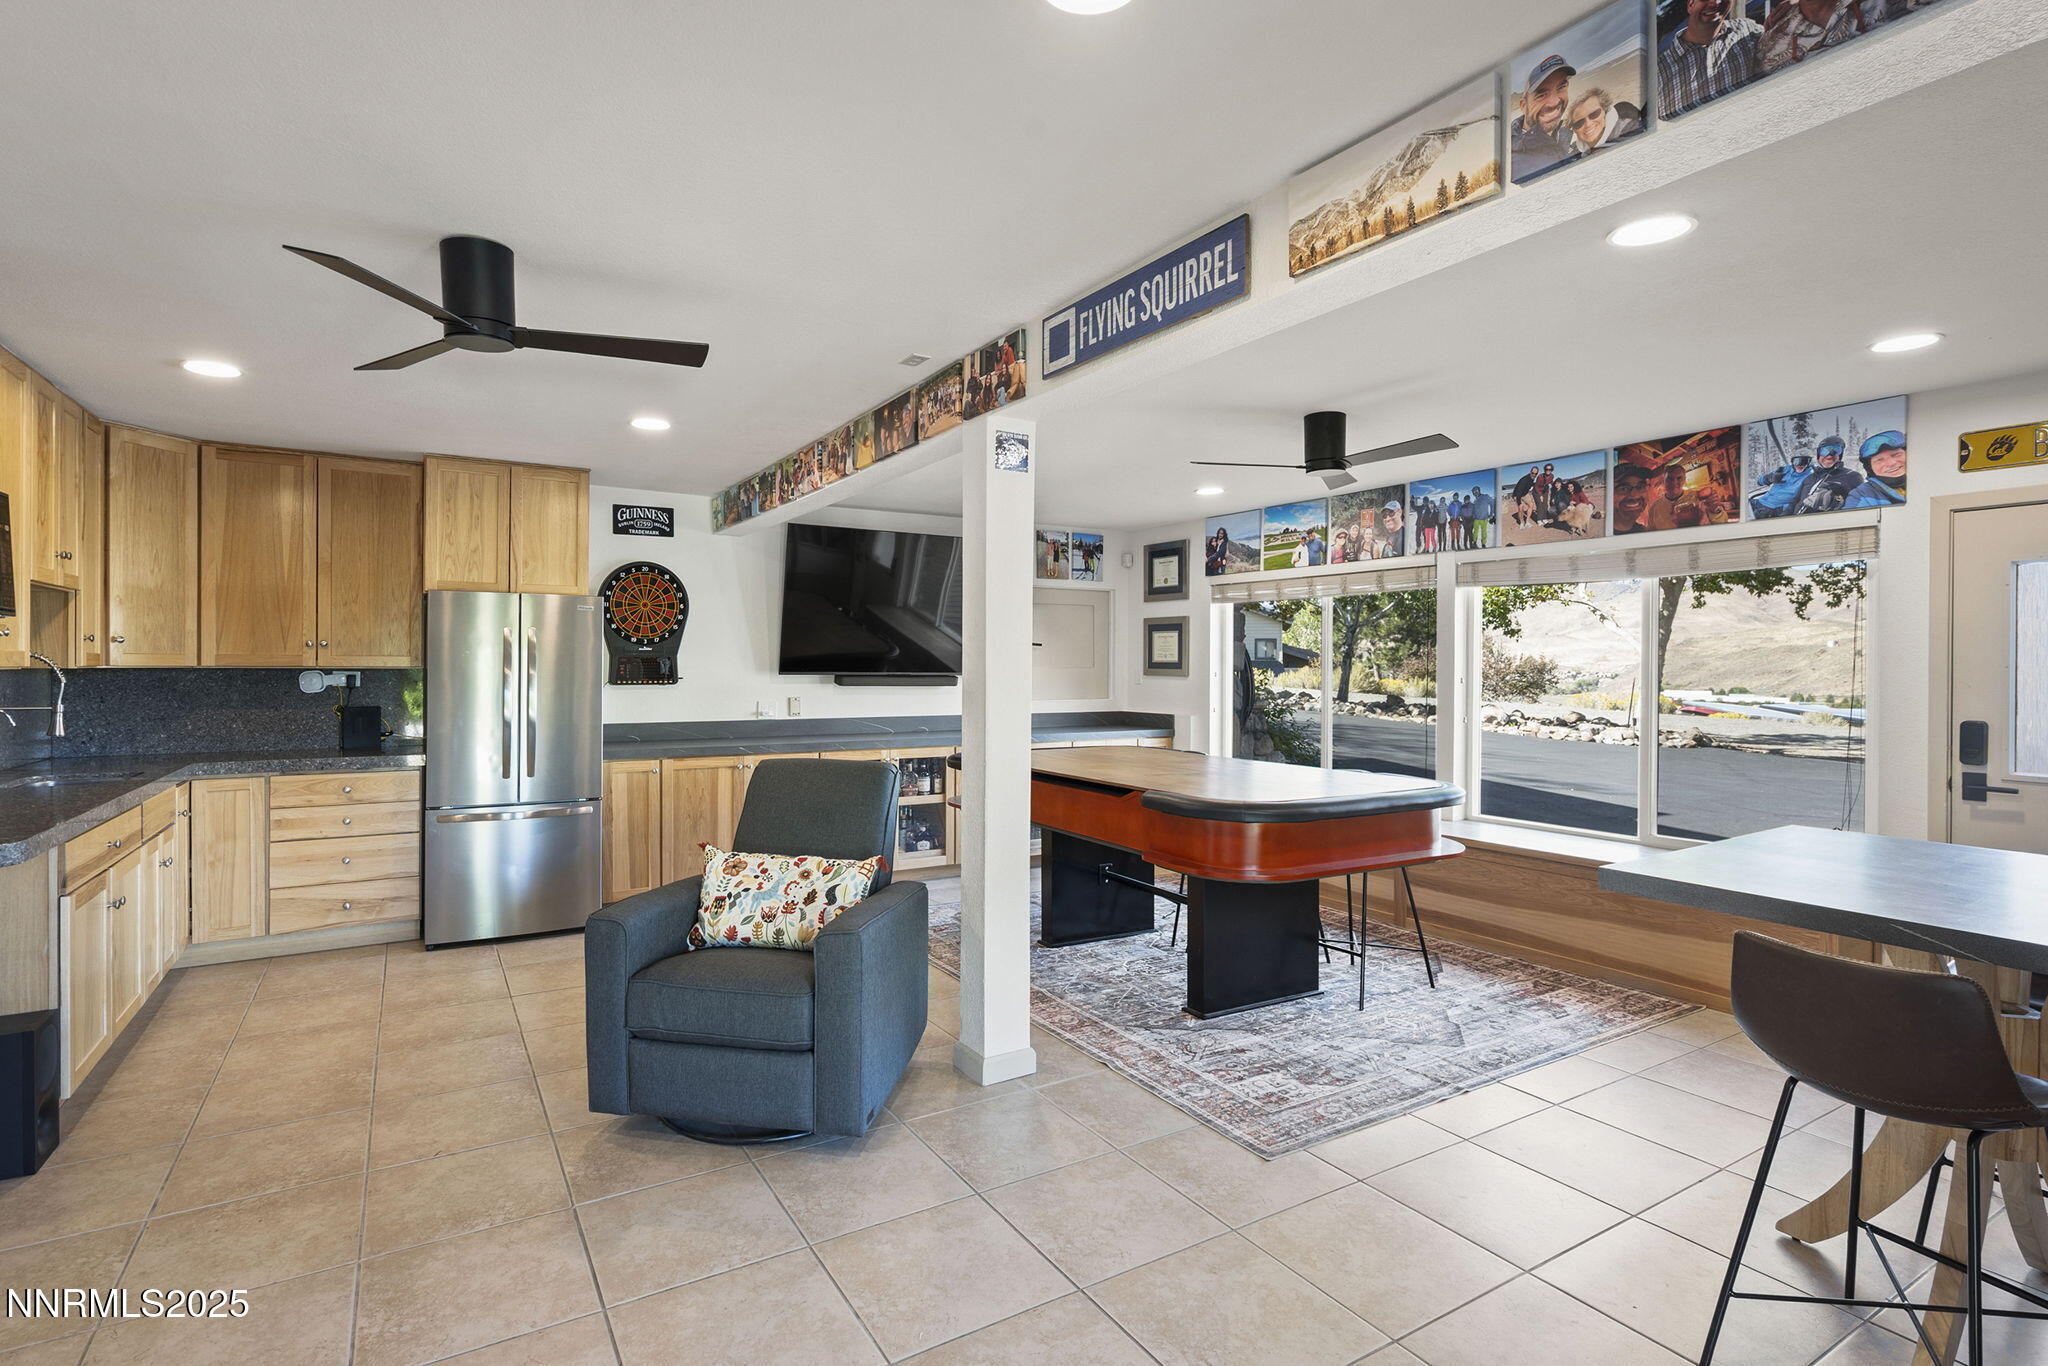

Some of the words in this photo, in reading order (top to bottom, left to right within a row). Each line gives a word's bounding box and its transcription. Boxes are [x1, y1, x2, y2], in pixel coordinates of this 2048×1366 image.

[1079, 288, 1136, 350] FLYING
[1139, 239, 1239, 323] SQUIRREL
[617, 507, 670, 525] GUINNESS
[628, 528, 660, 536] TRADEMARK
[653, 521, 671, 532] IRELAND
